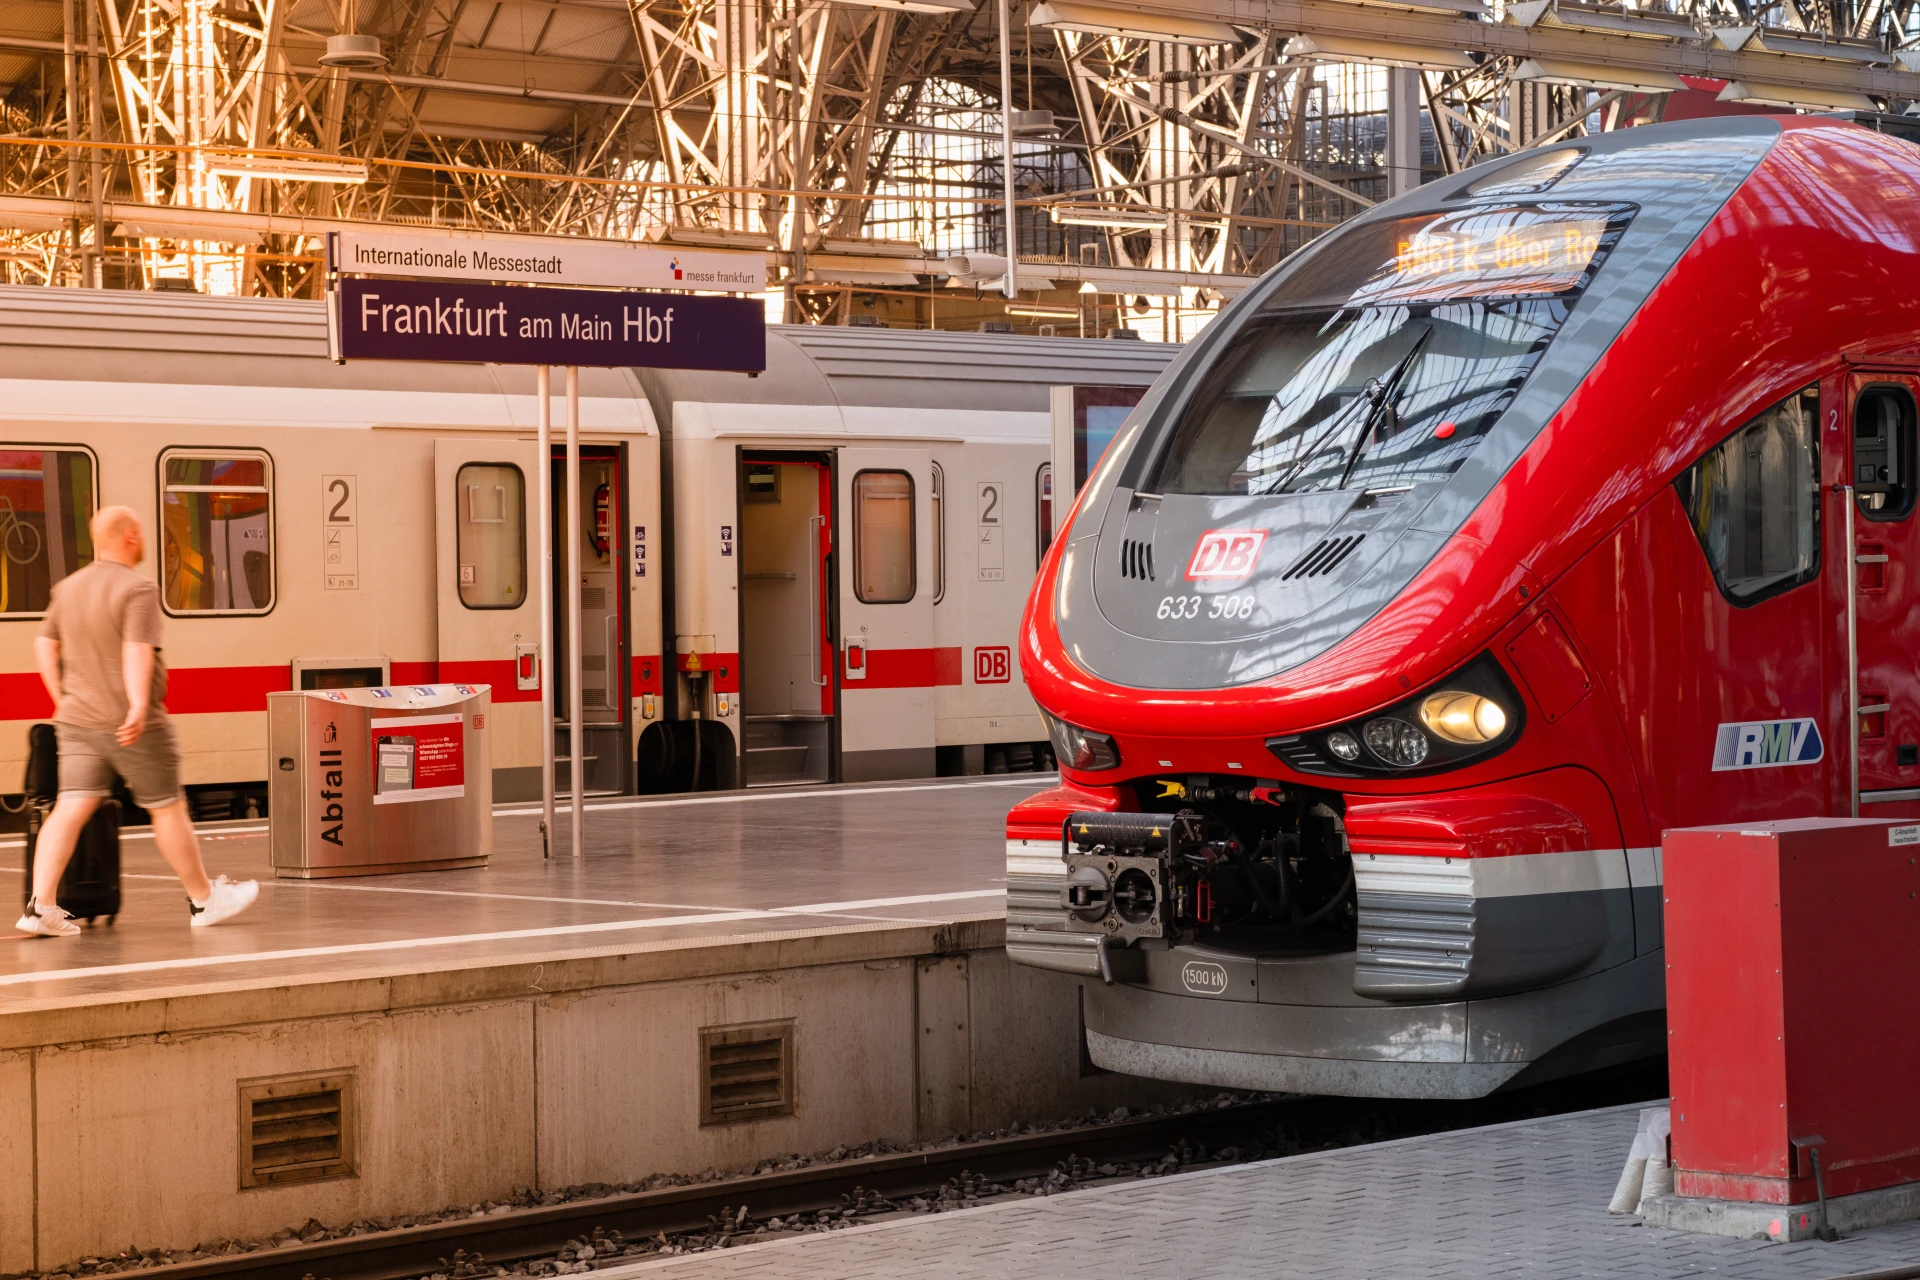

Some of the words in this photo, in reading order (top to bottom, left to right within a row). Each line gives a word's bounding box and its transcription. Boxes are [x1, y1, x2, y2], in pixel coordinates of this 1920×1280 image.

[355, 244, 467, 269] Internationale
[473, 251, 562, 274] Messestadt
[687, 272, 714, 282] messe
[717, 271, 755, 283] frankfurt
[361, 293, 508, 337] Frankfurt
[519, 317, 552, 338] am
[561, 312, 612, 341] Main
[623, 306, 674, 343] Hbf
[1829, 409, 1838, 430] 2
[328, 479, 350, 522] 2
[981, 486, 998, 523] 2
[1192, 535, 1257, 573] DB
[1156, 595, 1202, 620] 633
[1208, 595, 1256, 619] 508
[978, 651, 1008, 679] DB
[474, 716, 483, 728] DB
[1734, 720, 1812, 766] RMV
[320, 750, 343, 847] Abfall
[1185, 969, 1209, 985] 1500
[1211, 972, 1224, 986] kN
